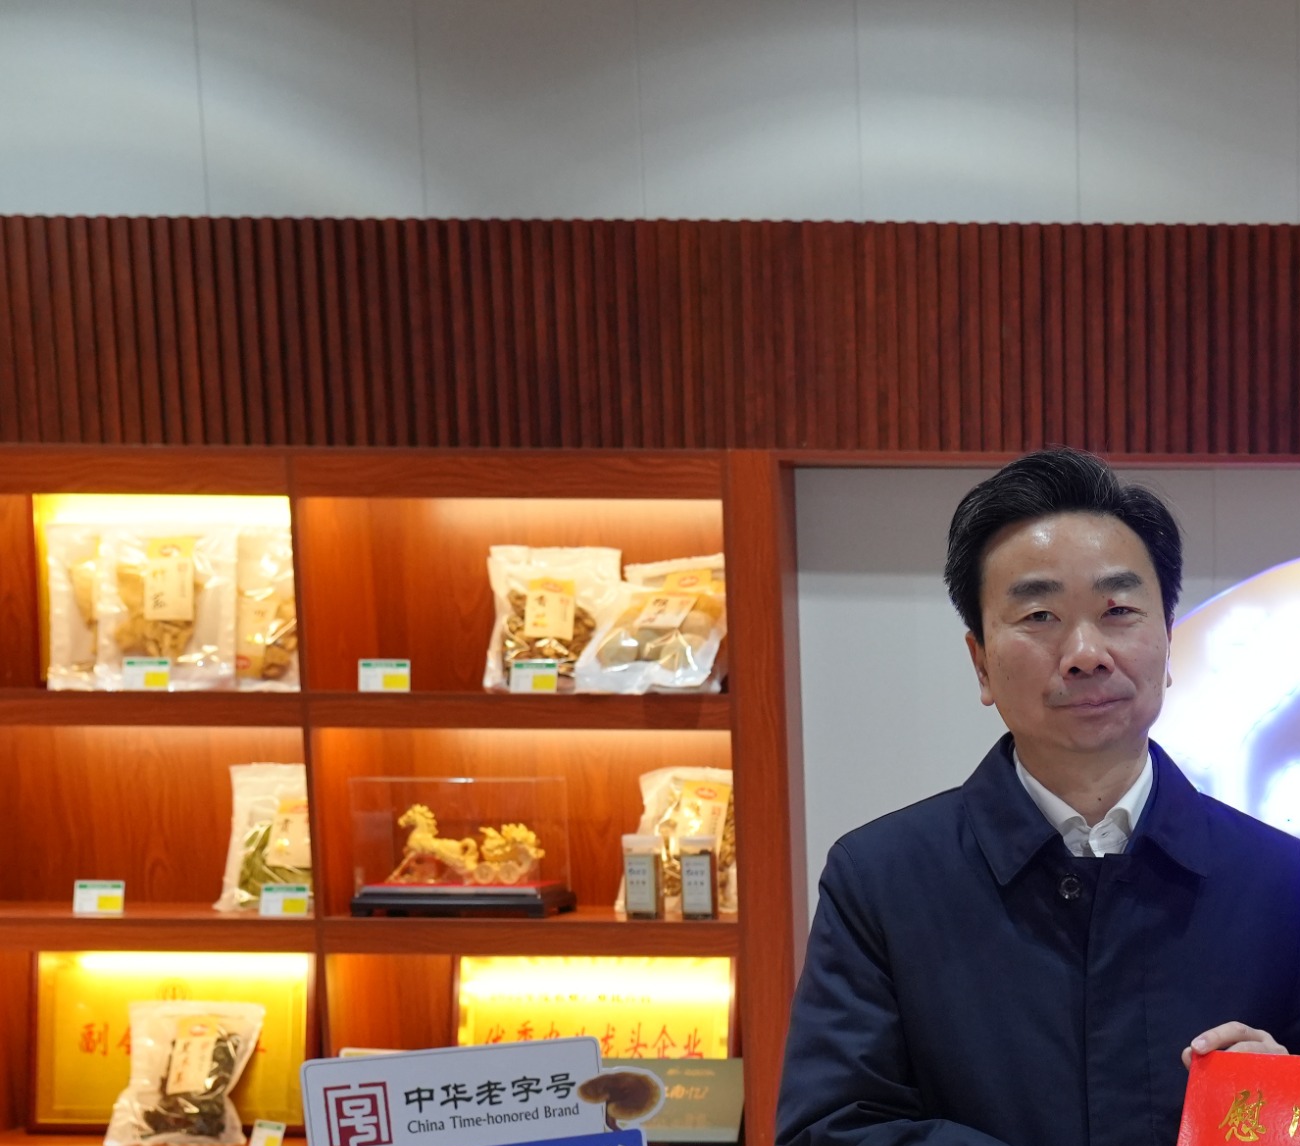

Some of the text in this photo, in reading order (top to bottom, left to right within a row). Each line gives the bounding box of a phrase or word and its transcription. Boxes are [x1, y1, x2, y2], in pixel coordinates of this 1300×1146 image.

[404, 1072, 577, 1114] 中华老字号
[406, 1102, 580, 1135] China Time-honored Brand
